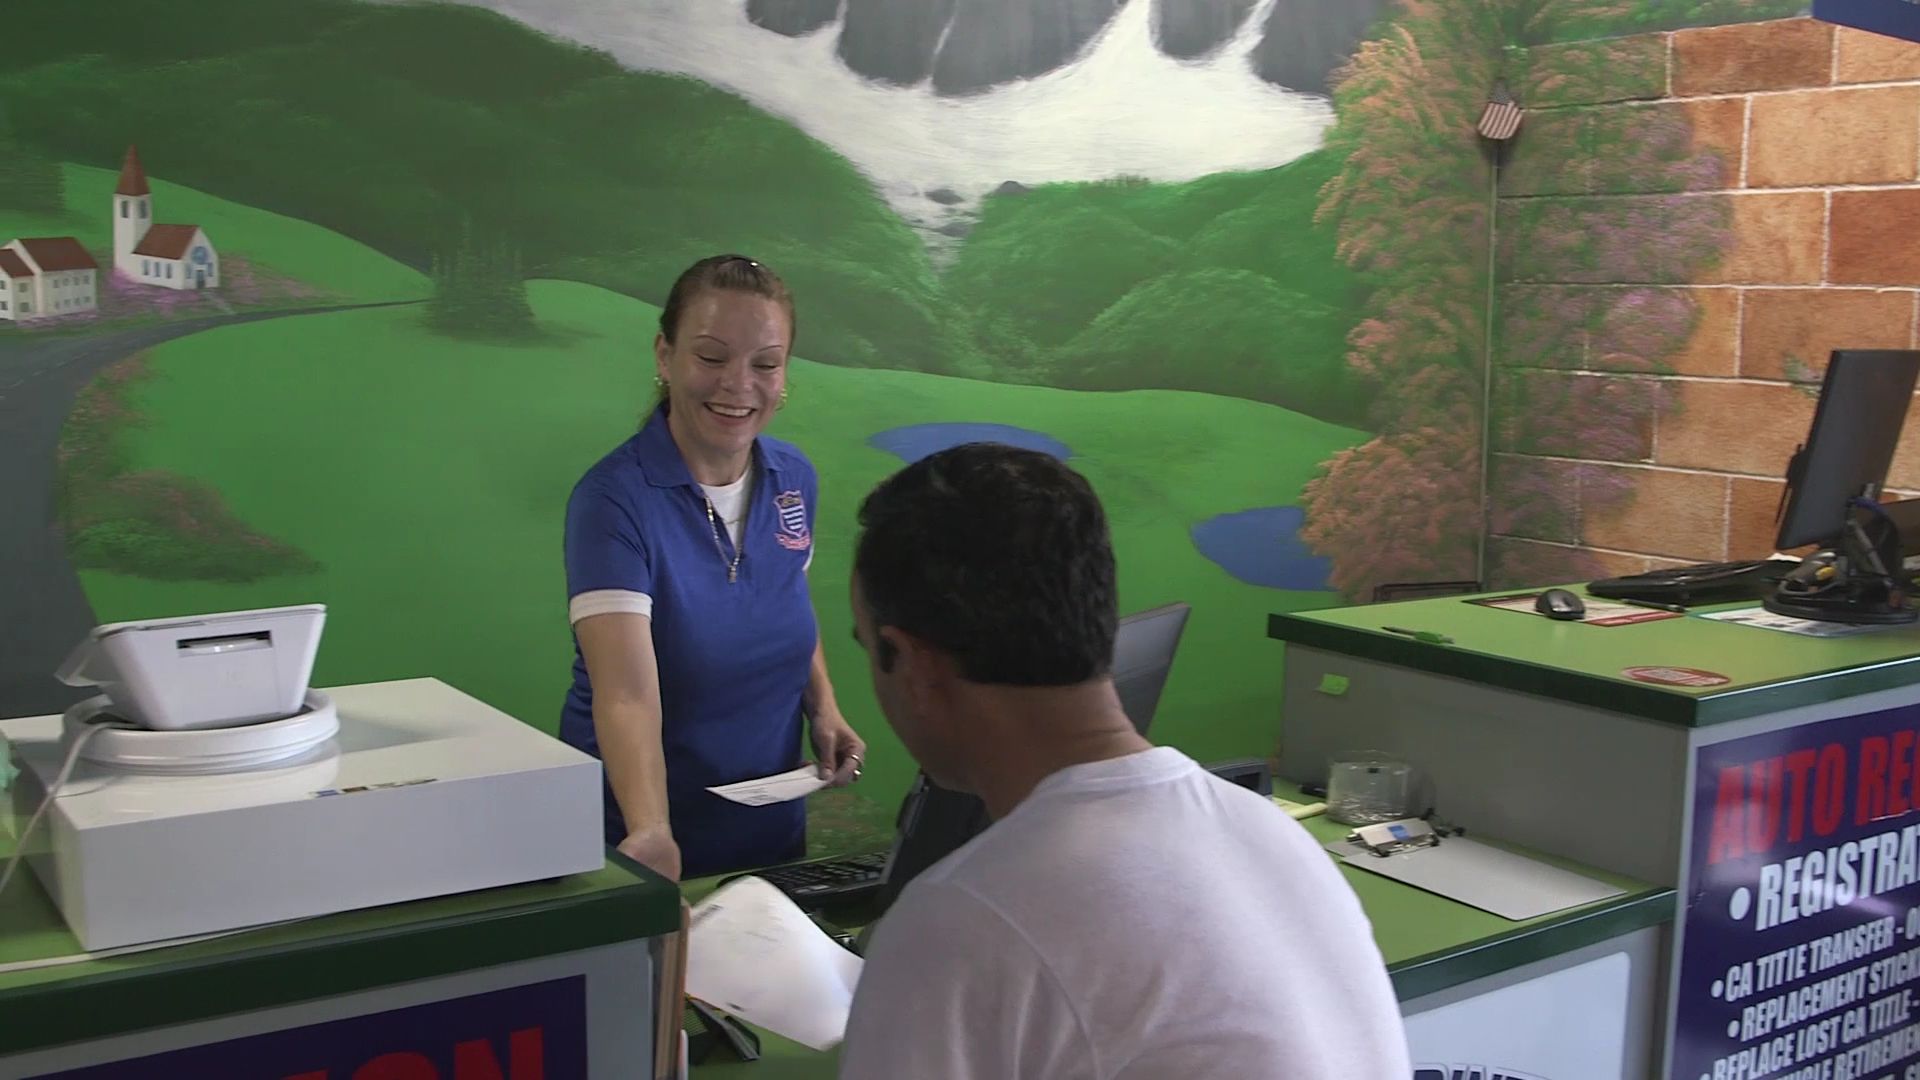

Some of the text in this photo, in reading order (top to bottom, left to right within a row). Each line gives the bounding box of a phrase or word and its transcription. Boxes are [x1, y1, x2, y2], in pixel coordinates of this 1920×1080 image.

[1707, 743, 1846, 864] AUTO
[1725, 961, 1753, 1002] CA
[1809, 915, 1895, 973] TRANSFER
[1712, 1032, 1796, 1080] REPLACE
[1795, 1015, 1842, 1062] LOST
[1842, 1006, 1868, 1044] CA
[1869, 988, 1913, 1034] TITLE
[1741, 966, 1869, 1042] REPLACEMENT
